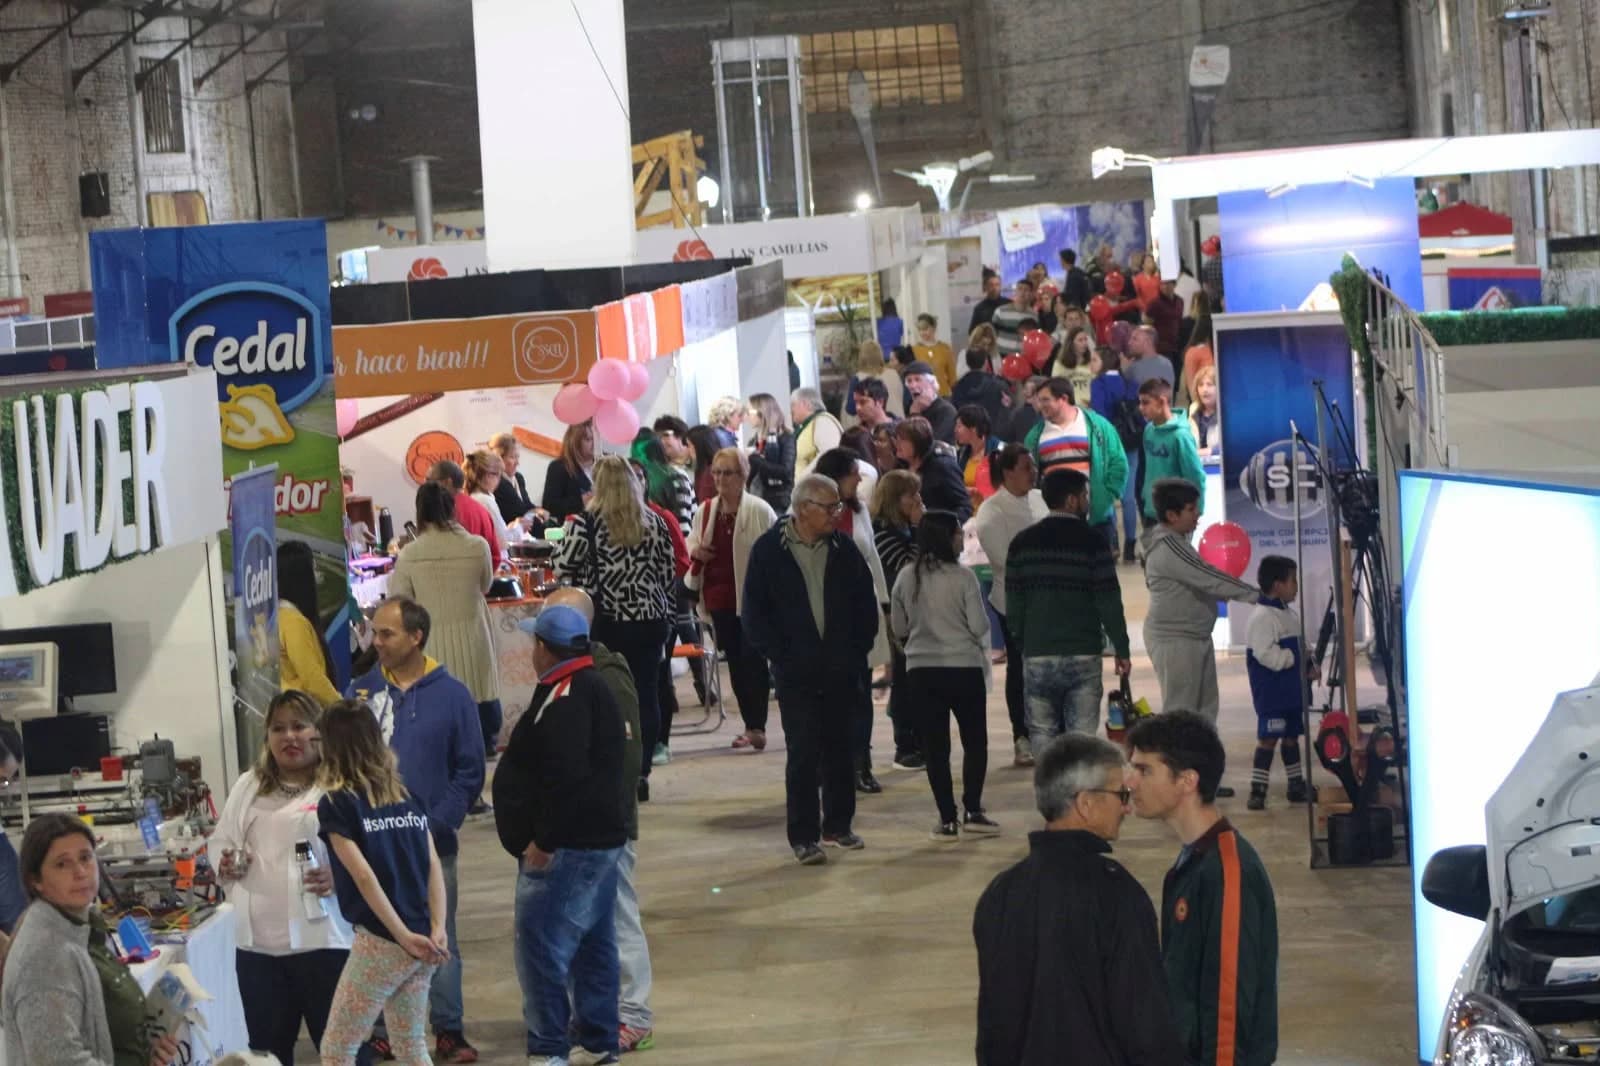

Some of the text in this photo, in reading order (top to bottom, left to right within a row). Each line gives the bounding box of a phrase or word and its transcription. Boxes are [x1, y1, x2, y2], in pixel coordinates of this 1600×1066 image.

[758, 241, 829, 257] CAMELIAS
[184, 317, 307, 376] Cedal
[355, 347, 408, 376] hace
[417, 339, 489, 371] bien!!!
[13, 381, 173, 586] UADER
[244, 555, 273, 608] Cedal
